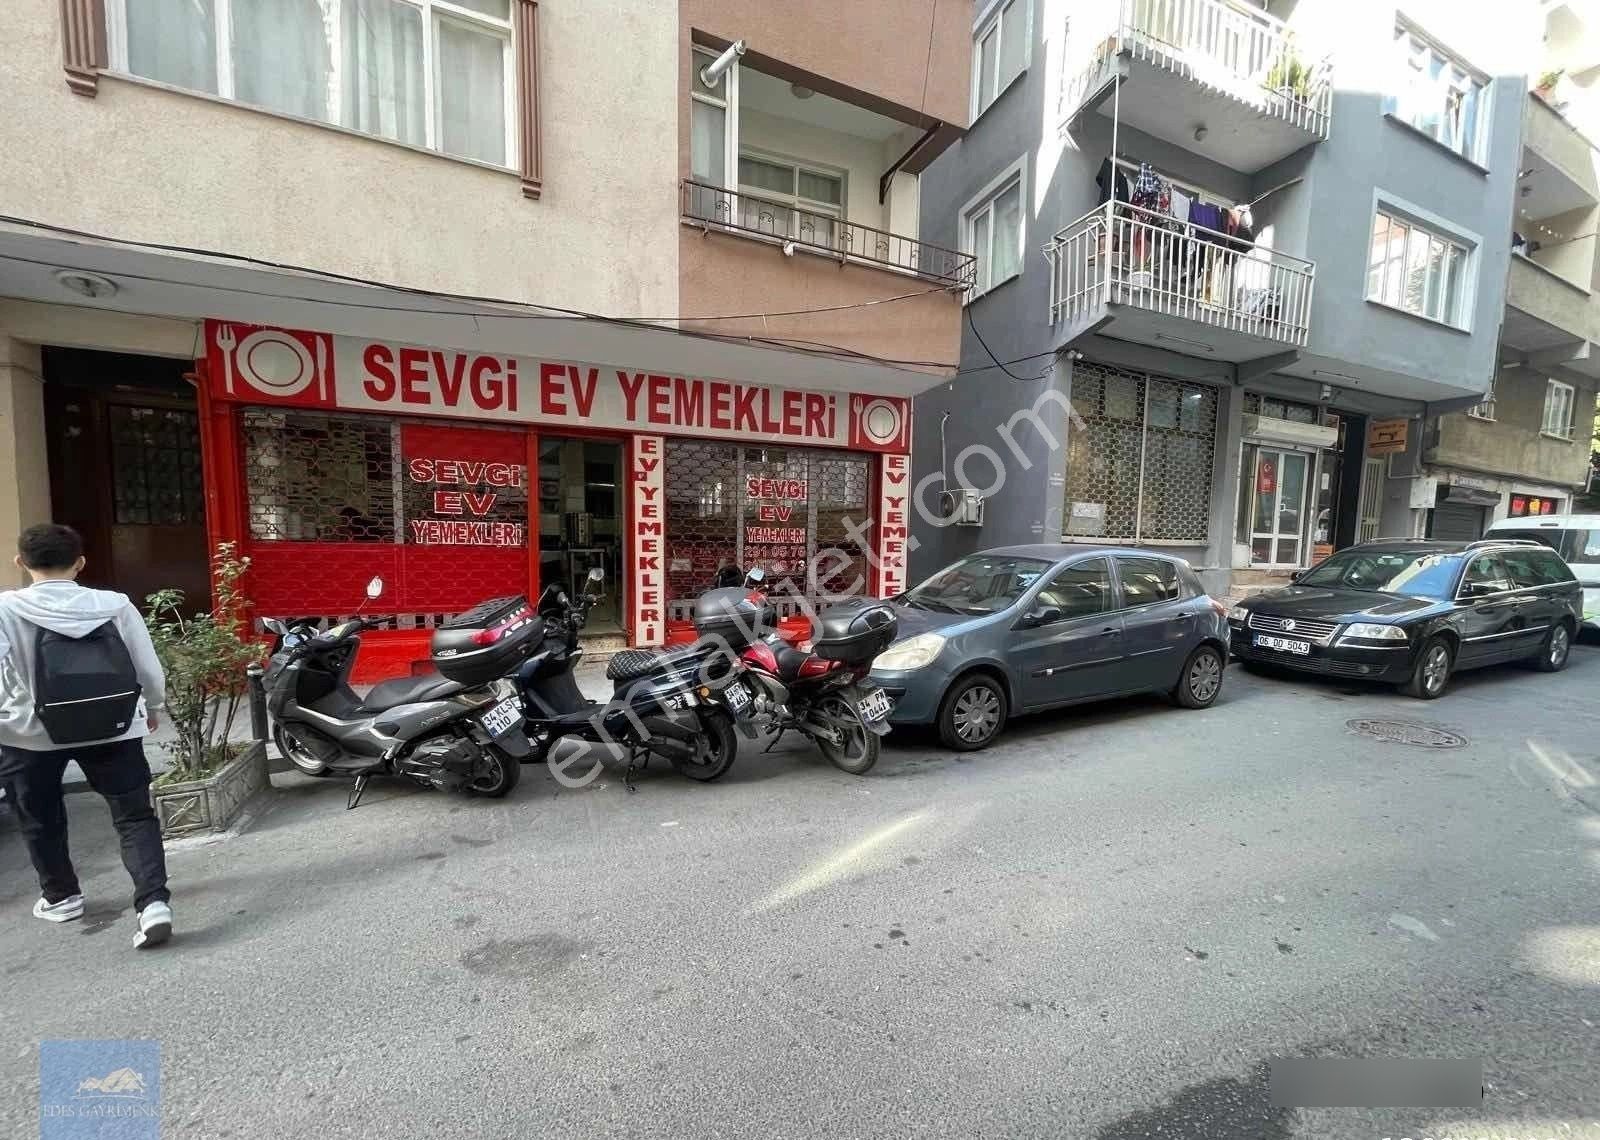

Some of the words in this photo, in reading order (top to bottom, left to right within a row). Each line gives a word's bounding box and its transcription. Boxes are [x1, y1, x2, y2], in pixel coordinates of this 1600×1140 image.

[540, 363, 599, 418] EV
[639, 439, 659, 472] EV
[886, 456, 906, 484] EV
[434, 490, 497, 515] EV
[760, 504, 793, 521] EV
[484, 713, 496, 726] 34
[494, 700, 513, 717] KLS
[860, 699, 870, 711] 34
[496, 715, 511, 731] 110
